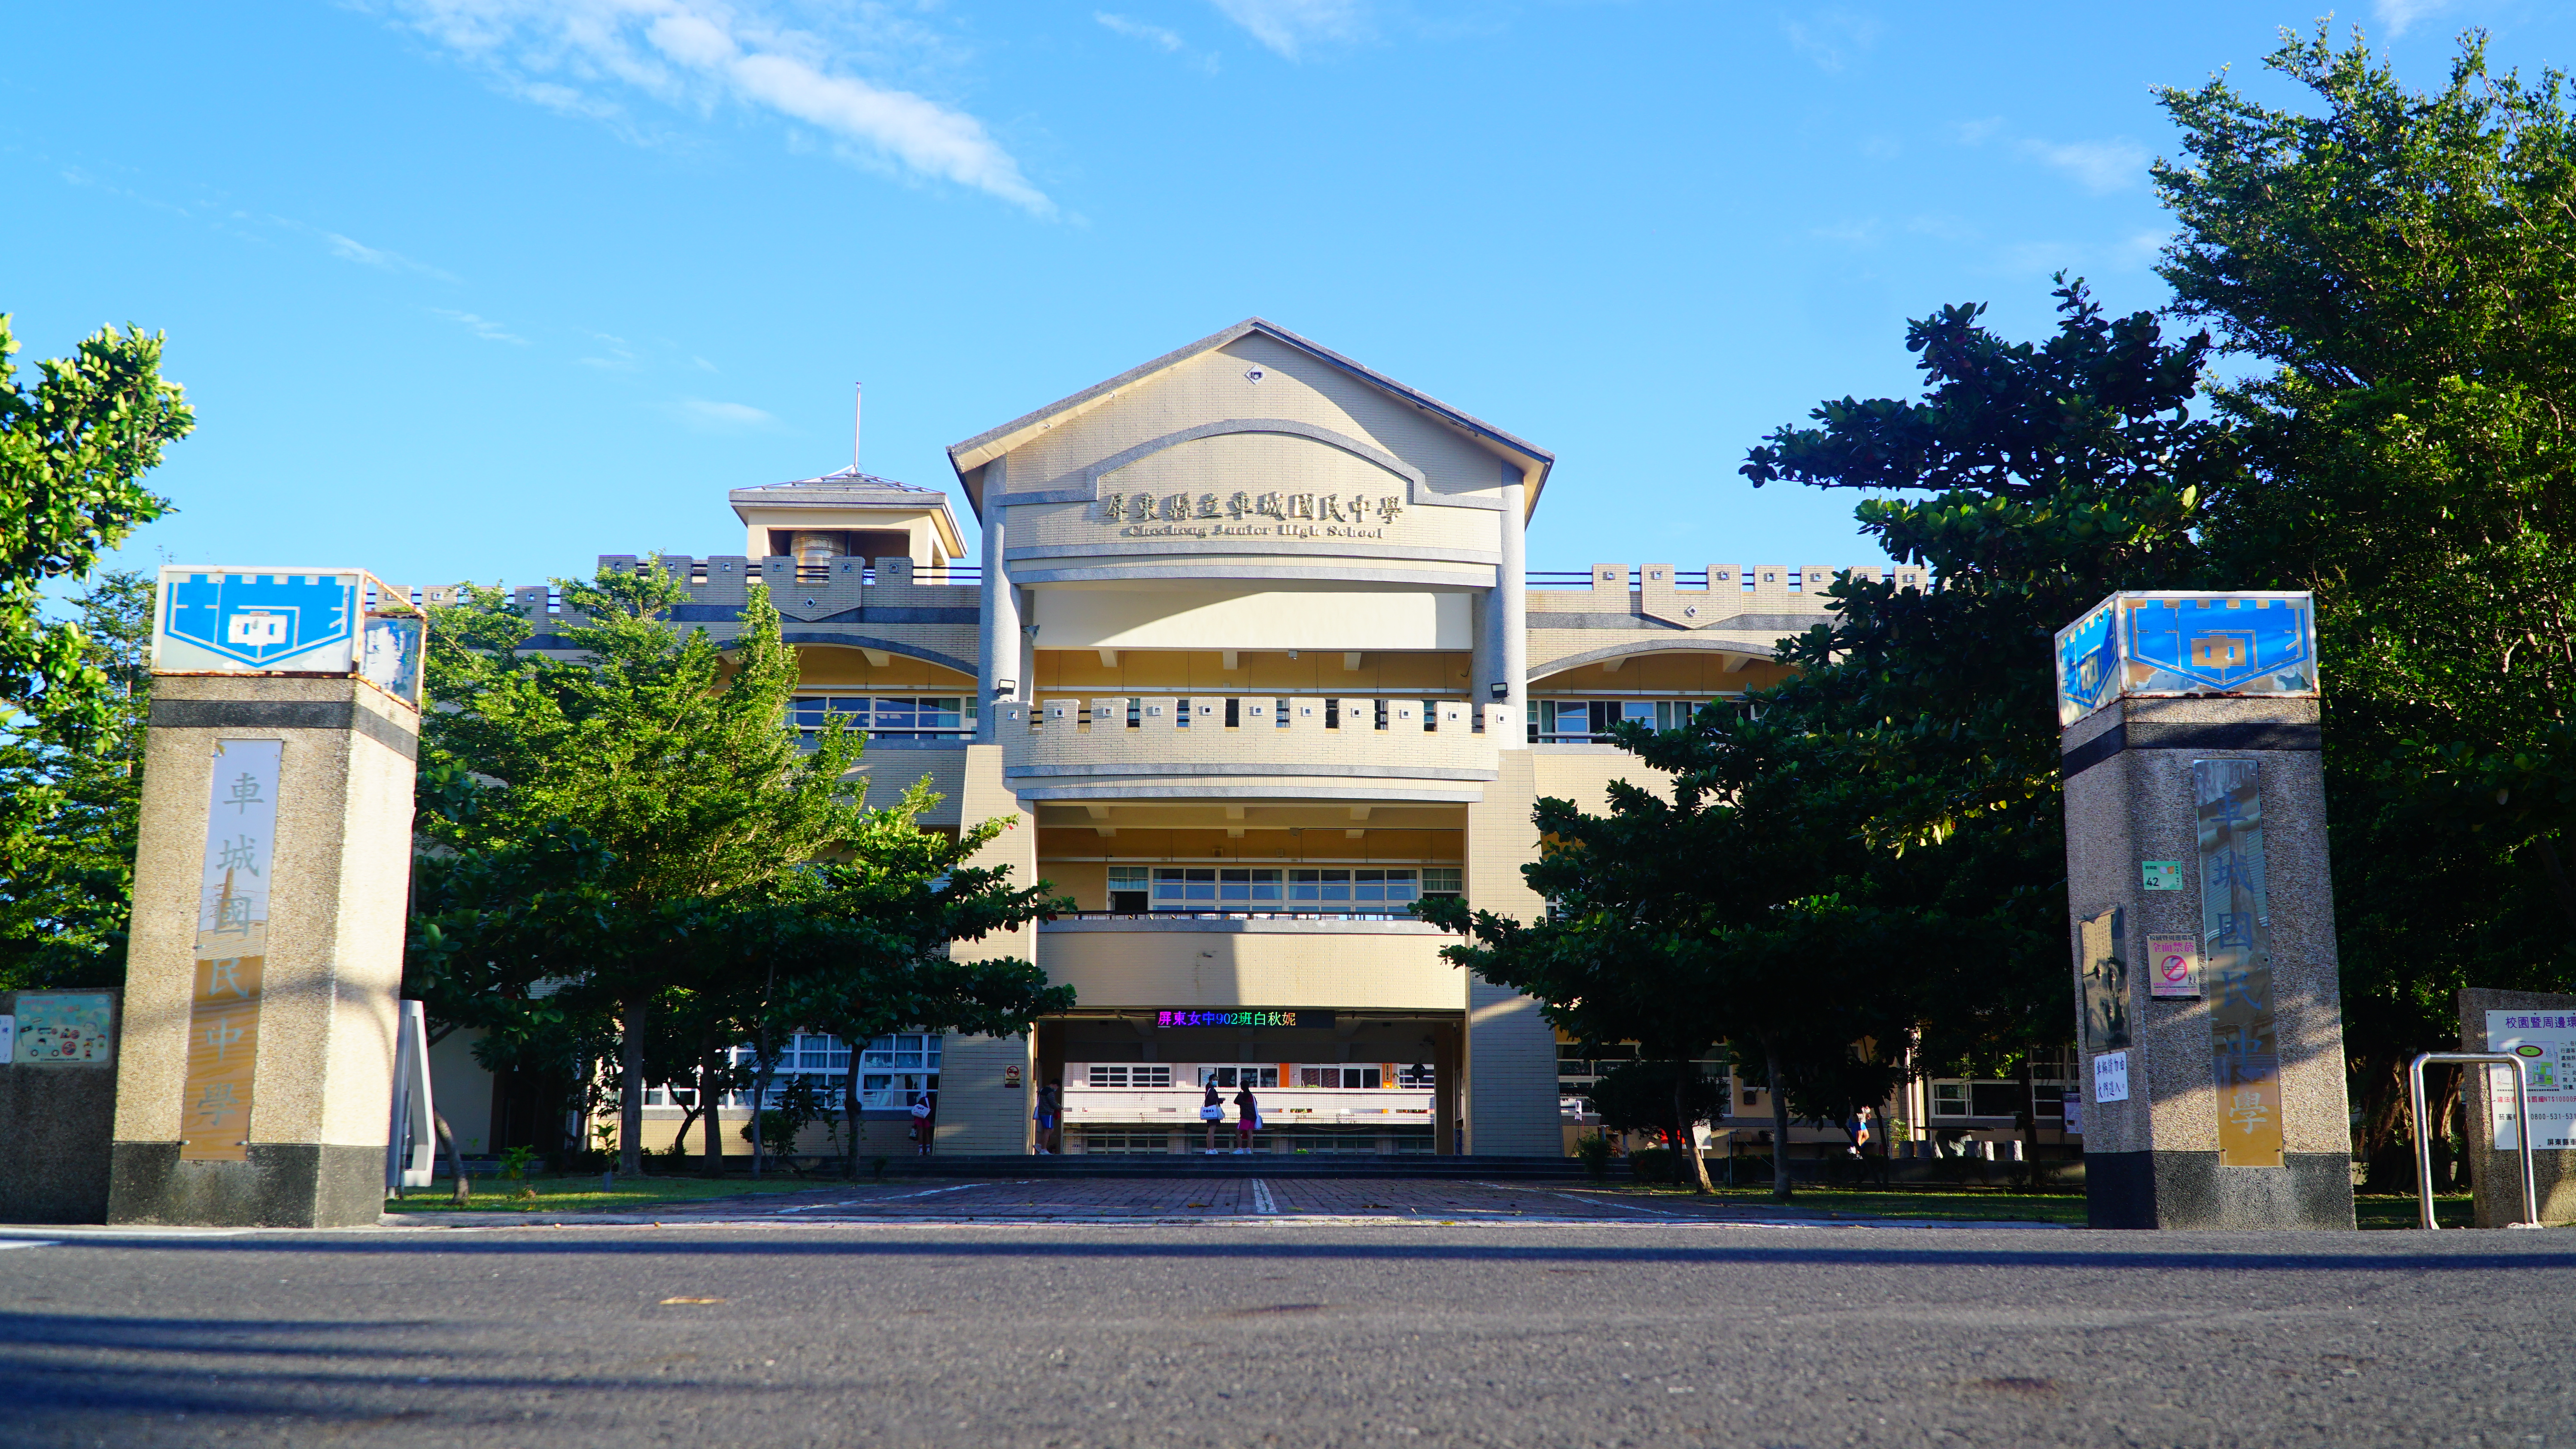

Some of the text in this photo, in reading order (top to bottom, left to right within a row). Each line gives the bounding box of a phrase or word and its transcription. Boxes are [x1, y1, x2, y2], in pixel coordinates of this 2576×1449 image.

[1106, 491, 1403, 524] 屏東縣立車城國民中學
[1129, 524, 1384, 539] Checheng Junior High School
[2147, 877, 2160, 886] 42
[197, 772, 264, 1125] 車城國民中學
[2152, 942, 2195, 952] 全面禁菸
[2210, 791, 2268, 1134] 車城國民中學
[1157, 1011, 1296, 1026] 屏東女中902班白秋妮
